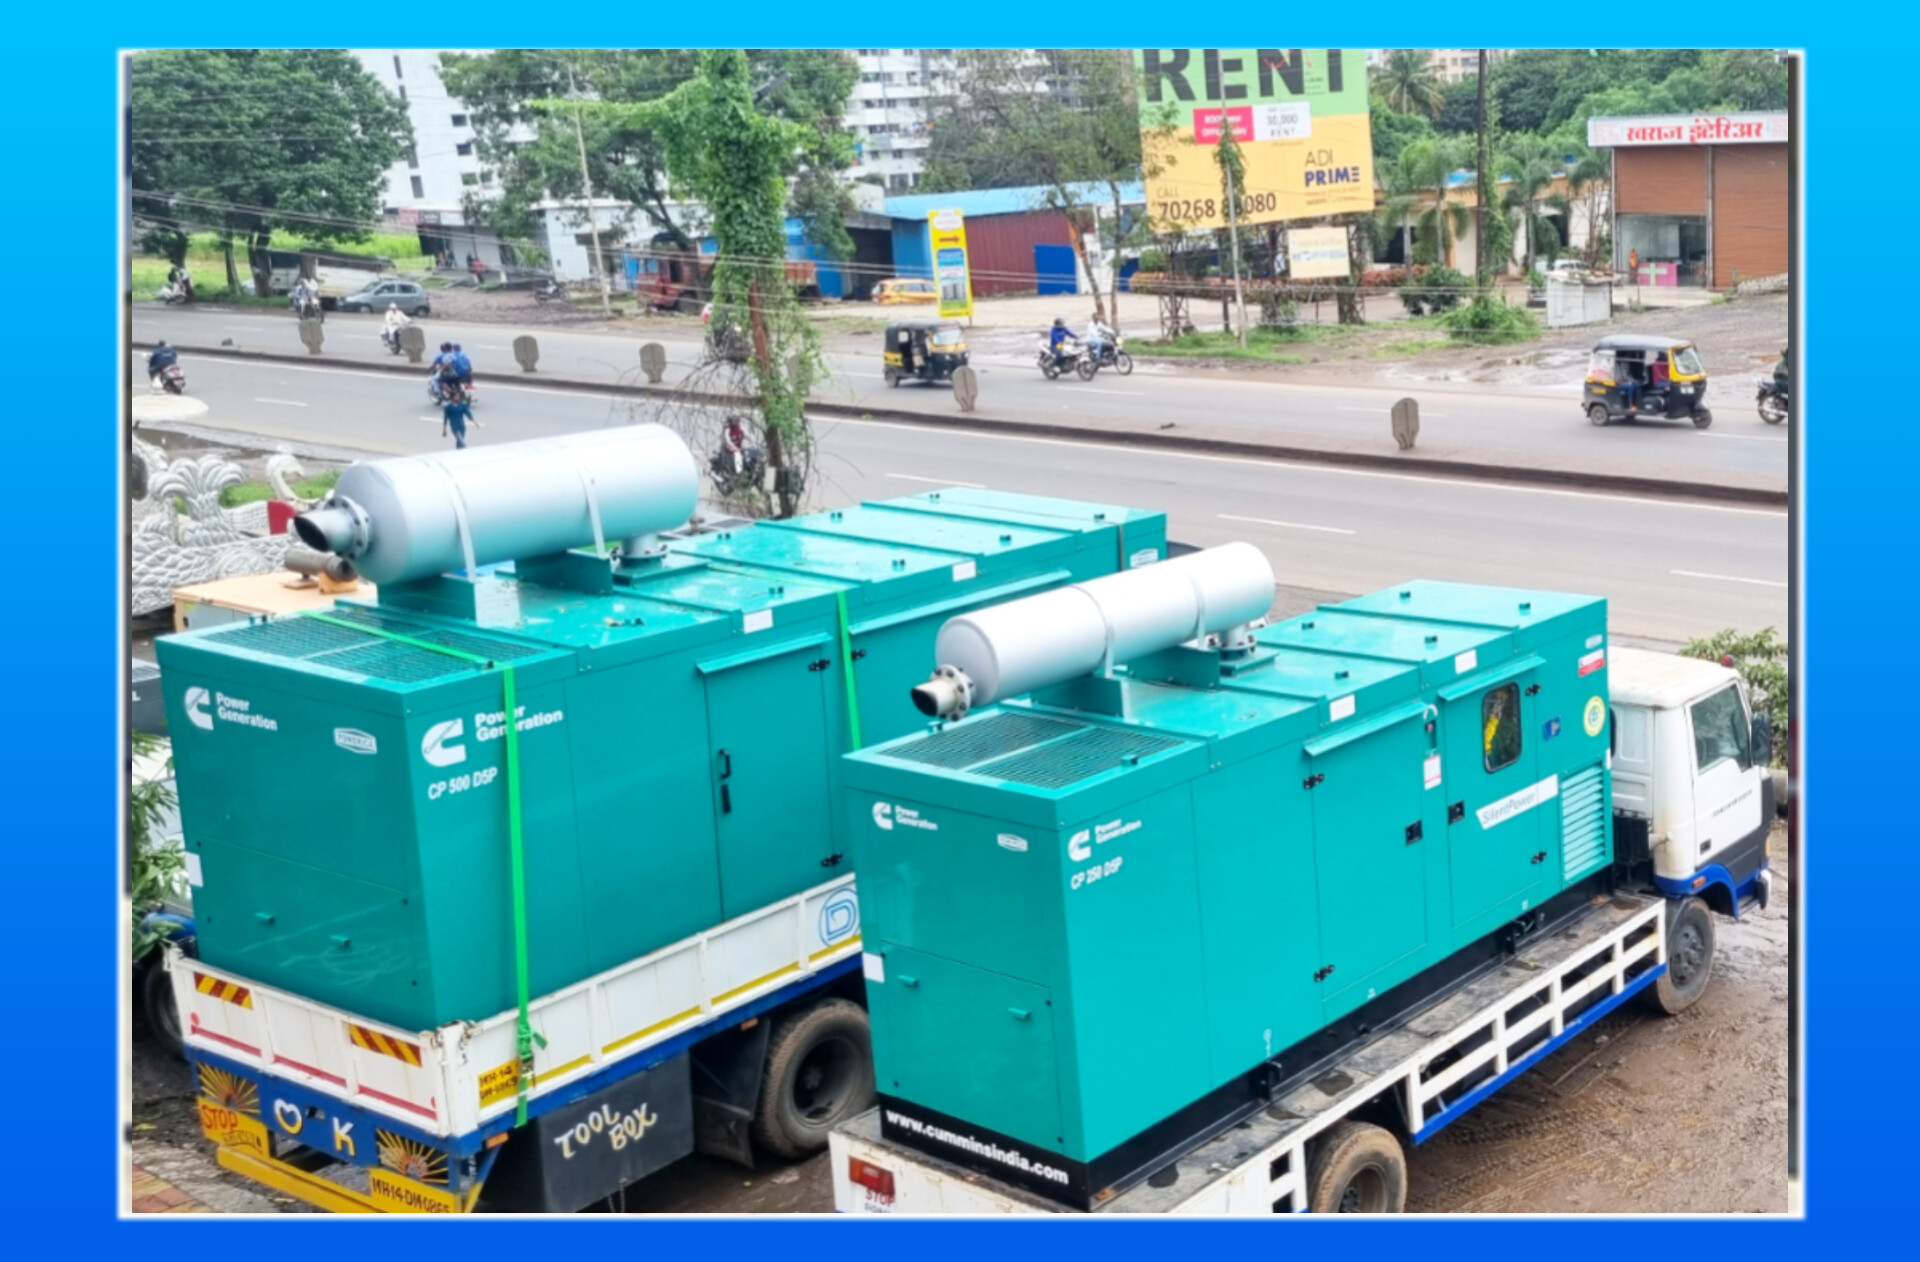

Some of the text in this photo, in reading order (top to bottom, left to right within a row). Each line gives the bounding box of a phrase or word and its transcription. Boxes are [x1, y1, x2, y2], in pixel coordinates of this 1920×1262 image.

[1305, 148, 1333, 167] ADI
[1304, 166, 1360, 188] PRIME
[1156, 186, 1179, 198] CALL
[1159, 198, 1216, 220] 70268
[215, 691, 249, 711] Power
[218, 705, 278, 731] Generation
[428, 780, 447, 800] CP
[448, 774, 471, 794] 500
[895, 805, 919, 819] Power
[896, 815, 938, 831] Generation
[1095, 819, 1122, 835] Power
[1096, 820, 1142, 844] Generation
[202, 1105, 239, 1131] STOP
[608, 1103, 657, 1151] BOX
[554, 1103, 620, 1159] TOOL
[886, 1110, 1069, 1185] www.cumminsindia.com
